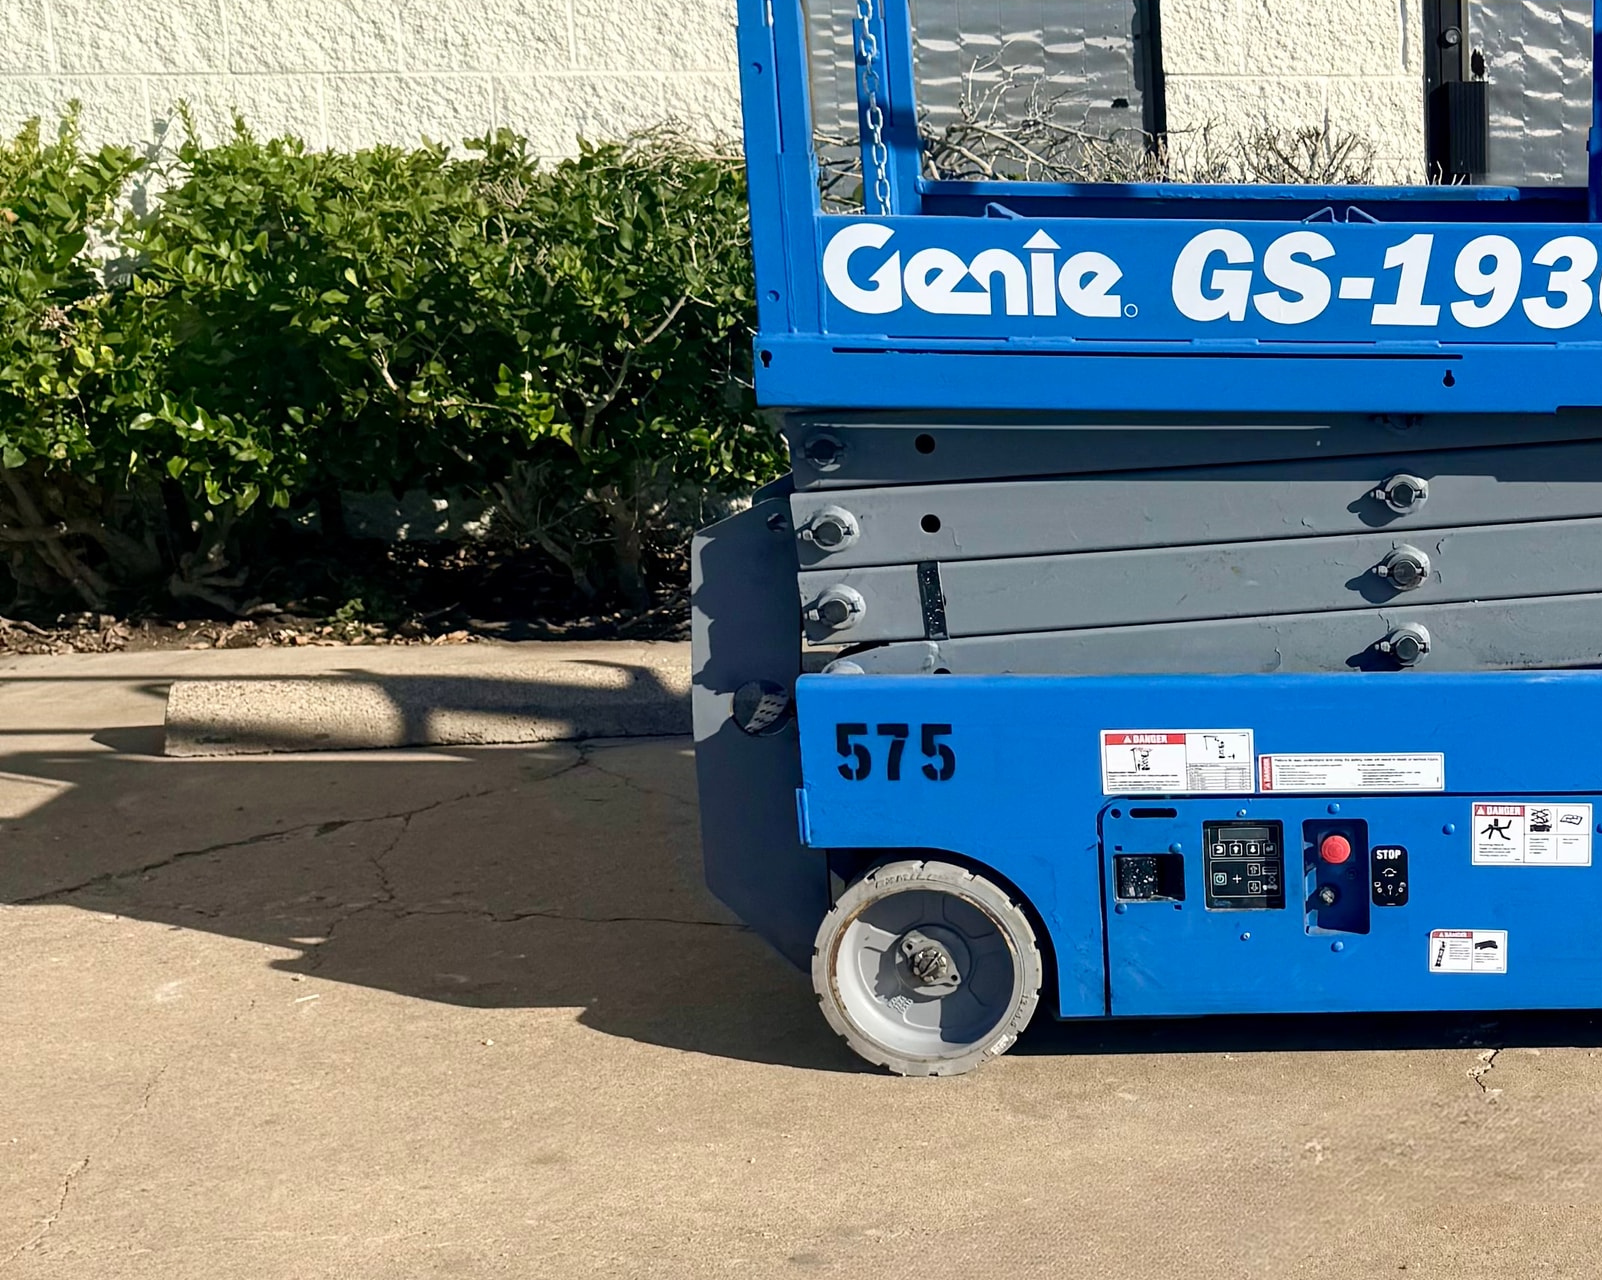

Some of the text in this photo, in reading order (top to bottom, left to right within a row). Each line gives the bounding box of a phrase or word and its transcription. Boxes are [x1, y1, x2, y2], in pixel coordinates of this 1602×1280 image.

[822, 223, 1122, 318] Genie
[1133, 734, 1168, 744] DANGER
[835, 723, 956, 781] 575
[1486, 806, 1521, 816] DANGER
[1376, 849, 1402, 860] STOP
